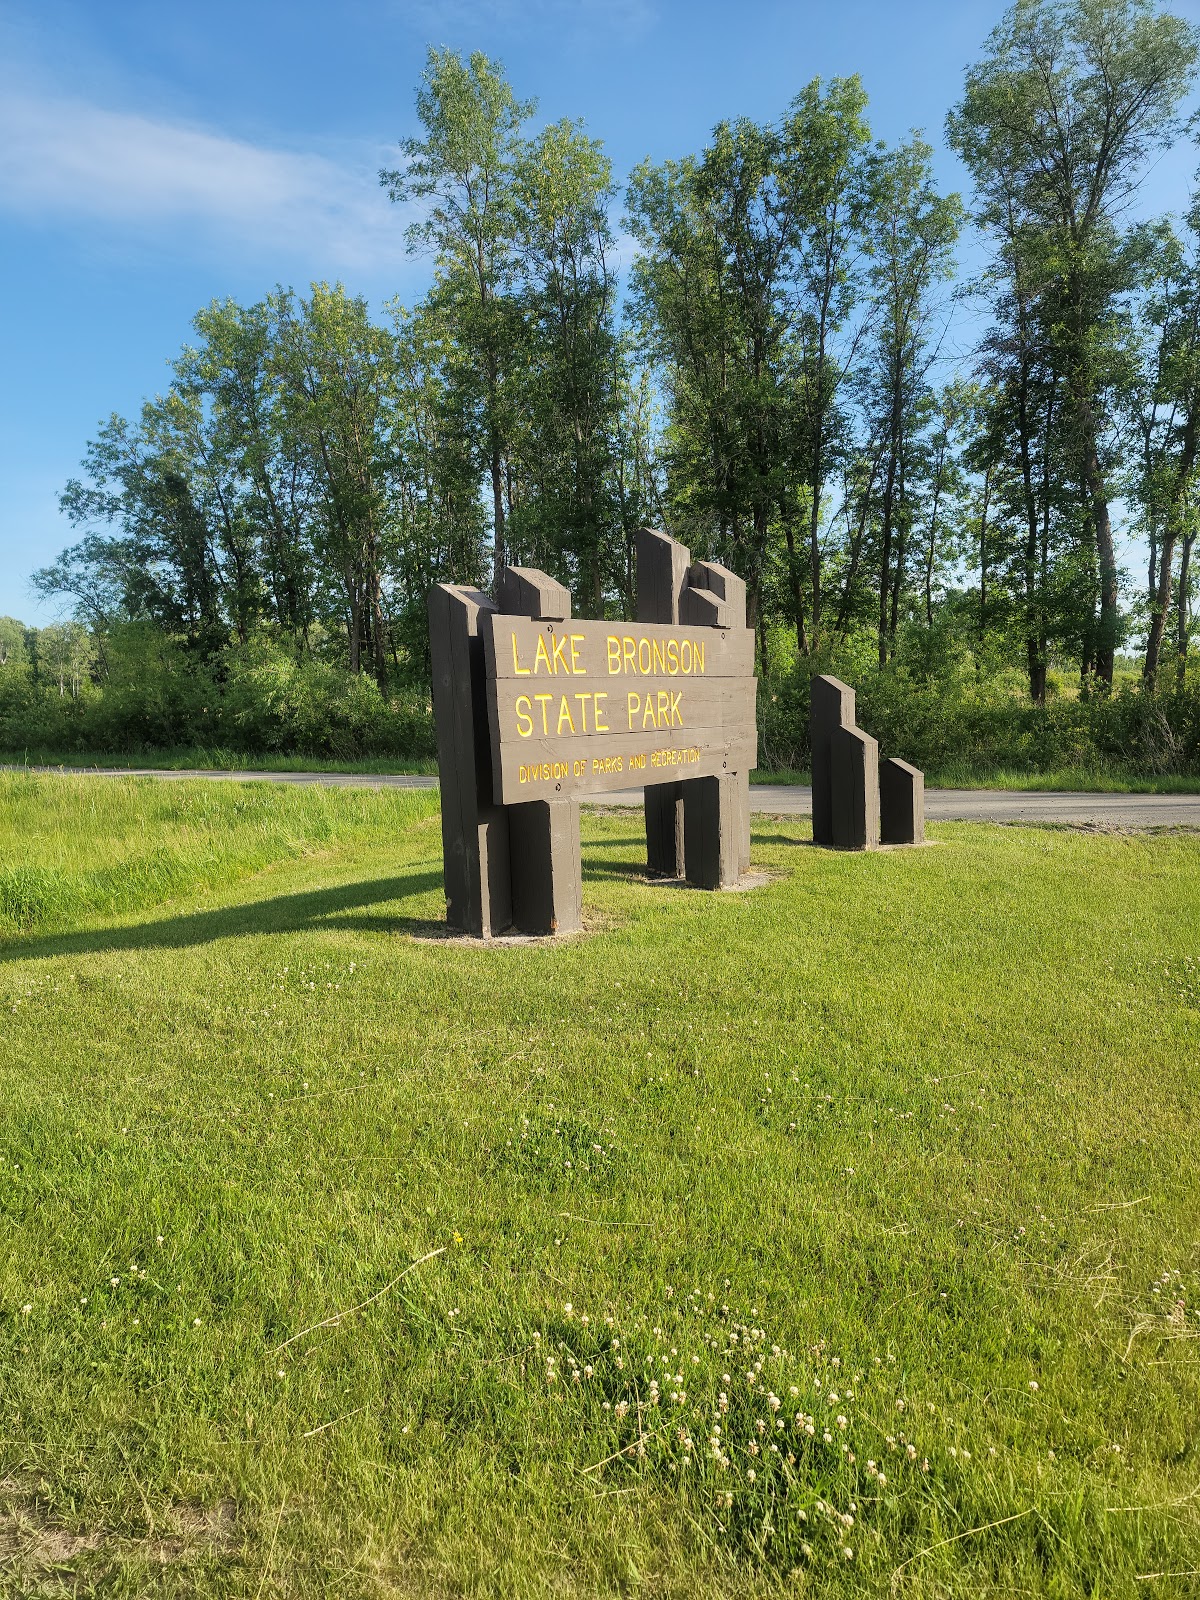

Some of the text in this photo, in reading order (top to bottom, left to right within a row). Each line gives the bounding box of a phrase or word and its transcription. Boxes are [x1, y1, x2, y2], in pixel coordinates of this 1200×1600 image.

[511, 632, 705, 675] LAKE BRONSON
[515, 690, 684, 737] STATE PARK
[519, 748, 701, 784] DIVISION OF PARKS AND RECREATION
